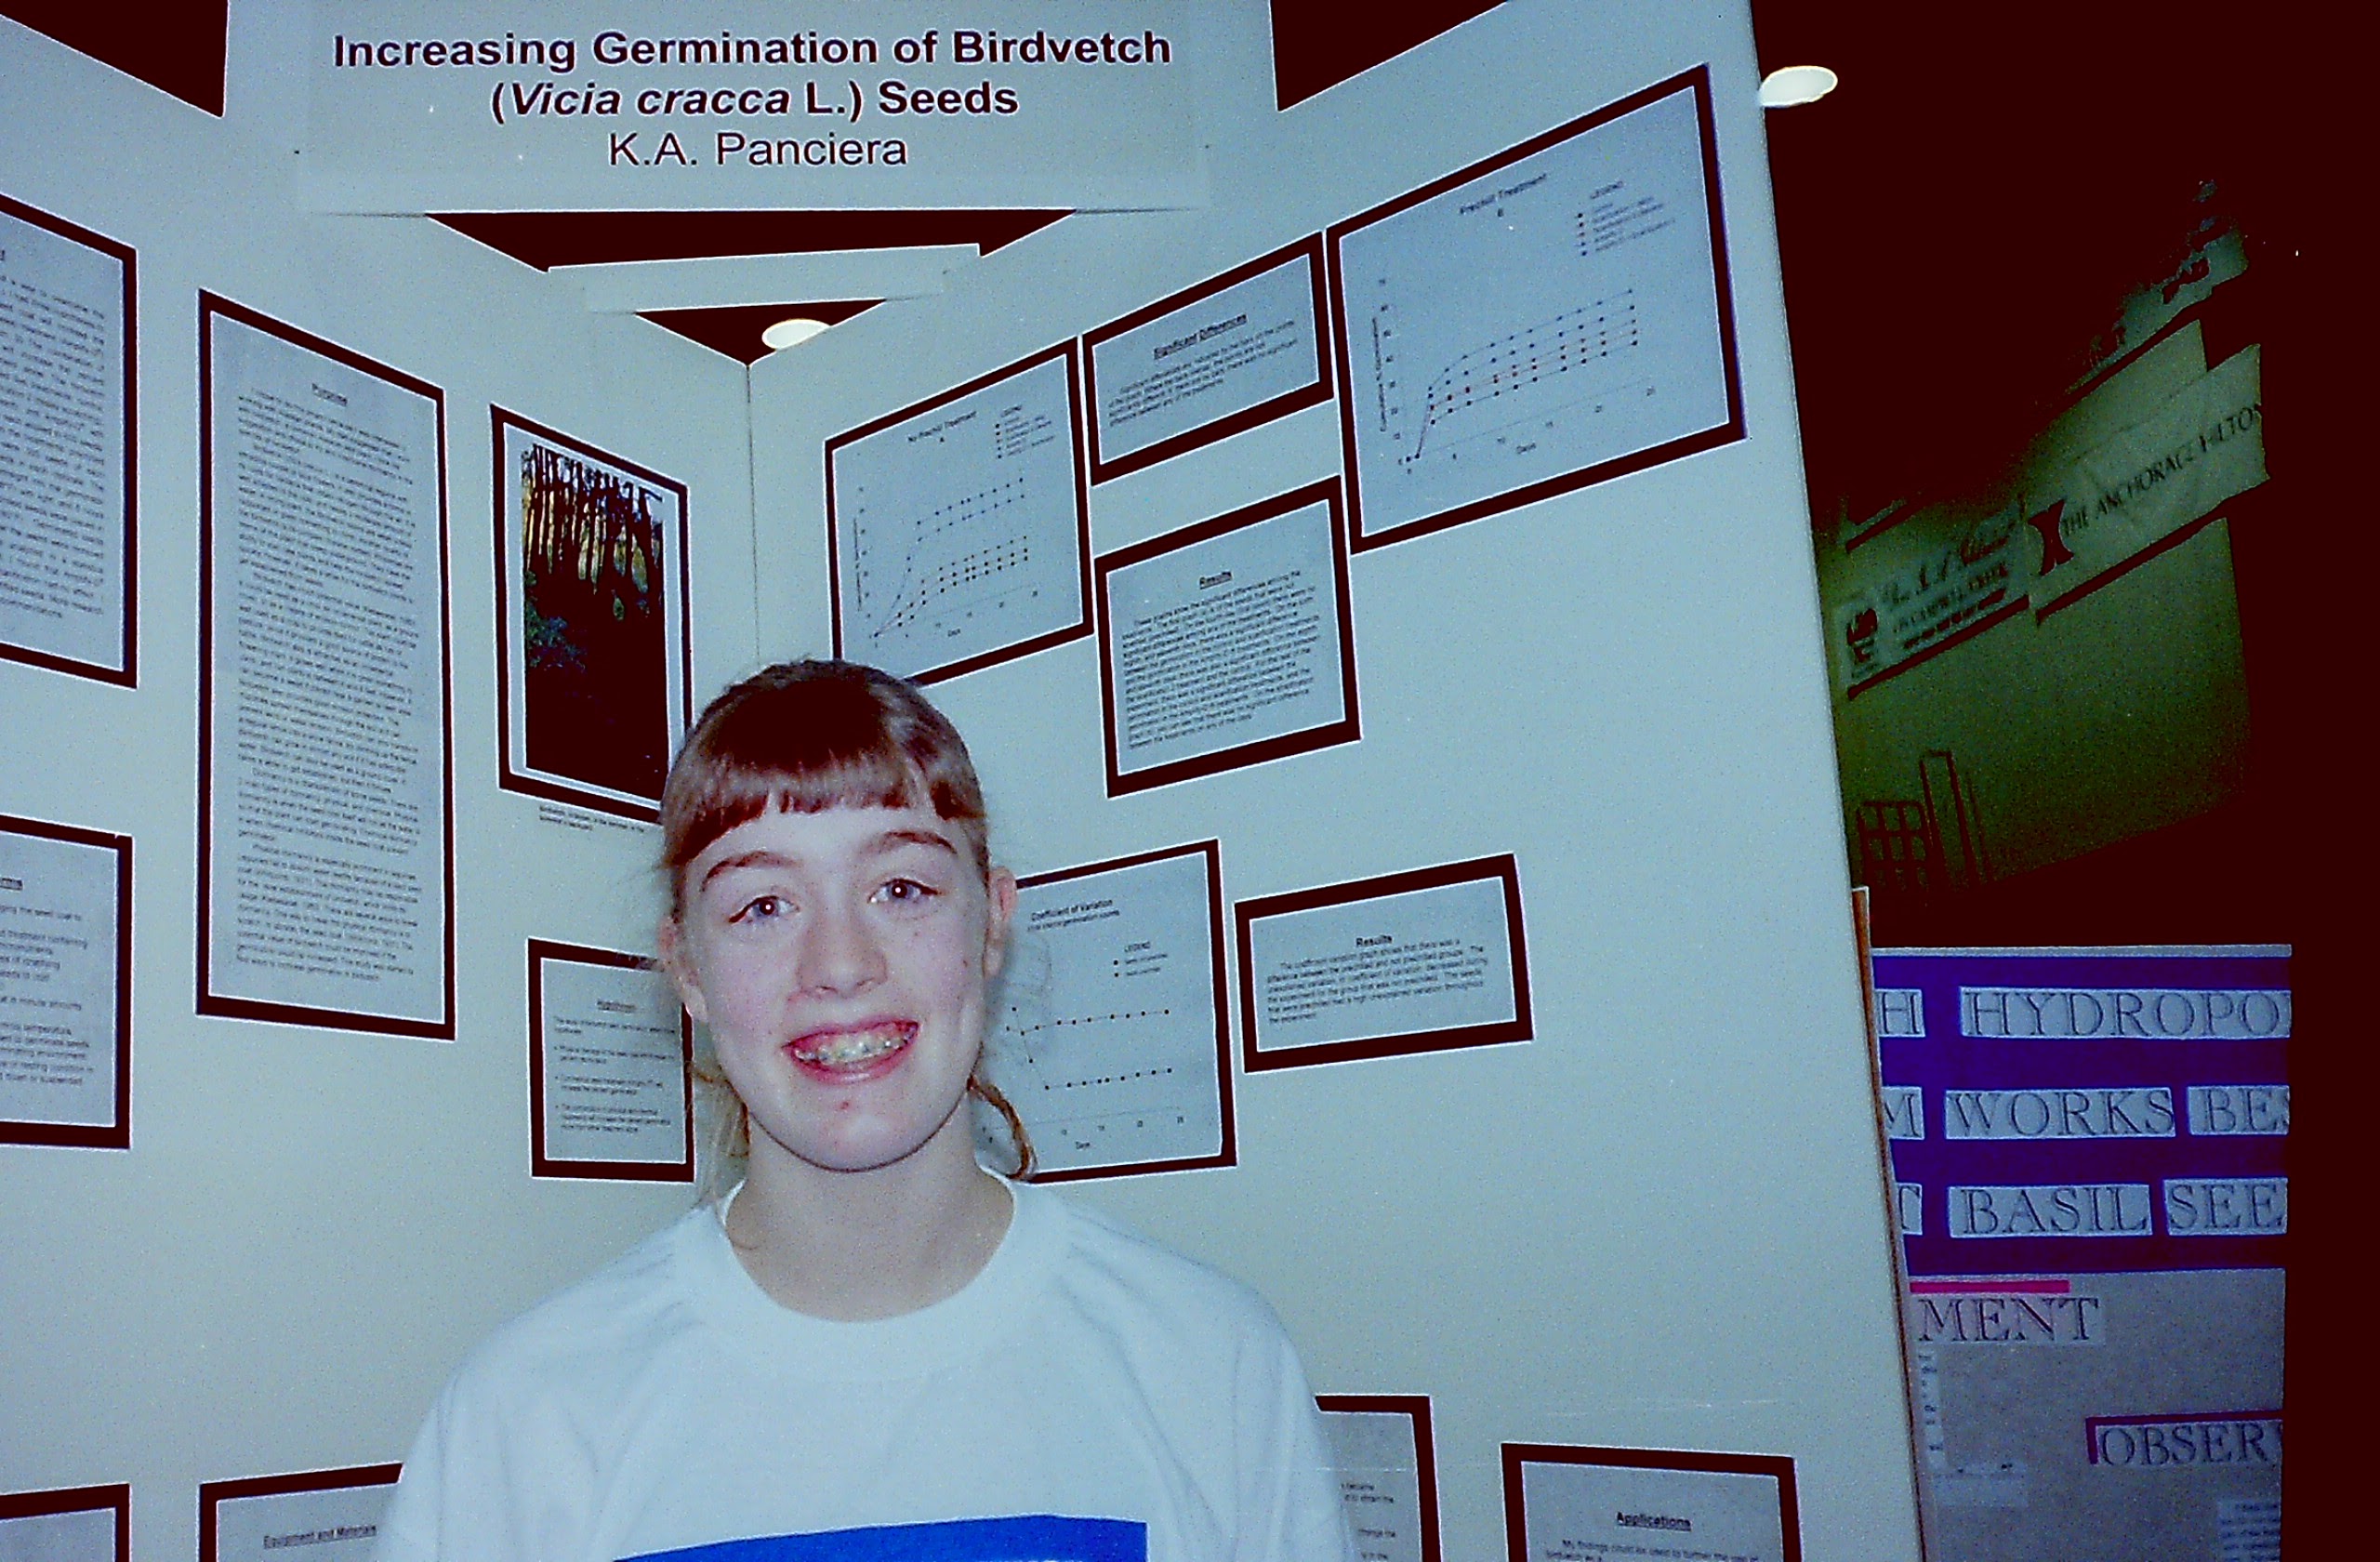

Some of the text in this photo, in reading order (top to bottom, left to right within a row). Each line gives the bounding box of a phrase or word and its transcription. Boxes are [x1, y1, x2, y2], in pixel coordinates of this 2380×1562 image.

[334, 30, 1170, 73] Increasing Germination of Birdvetch
[492, 80, 1018, 124] (Vicia cracca L.) Seeds
[610, 131, 906, 165] K.A. Panciera
[1153, 312, 1248, 361] Significant Differences
[2199, 403, 2262, 454] HILTO
[1355, 933, 1393, 948] Results
[1875, 991, 2290, 1038] H HYDROPO
[1949, 1092, 2175, 1137] WORKS
[1962, 1188, 2149, 1235] BASIL
[1918, 1298, 2099, 1343] MENT
[2100, 1421, 2283, 1467] OBSER
[1617, 1511, 1692, 1532] Applications
